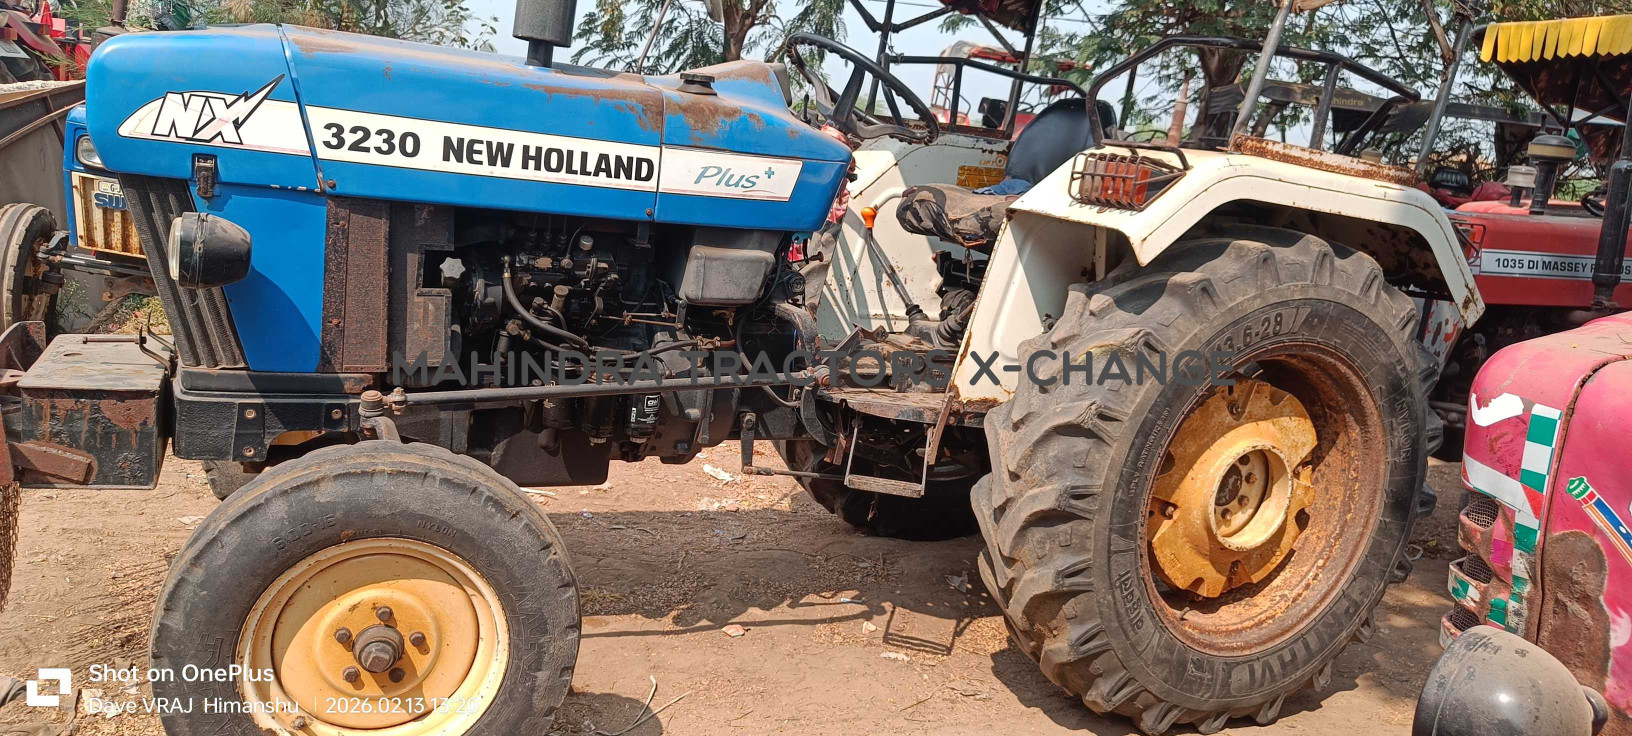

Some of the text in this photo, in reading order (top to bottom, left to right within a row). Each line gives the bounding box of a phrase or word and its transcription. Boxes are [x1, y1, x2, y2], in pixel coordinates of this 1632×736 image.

[151, 73, 286, 145] NX
[1321, 95, 1364, 106] hindra
[322, 122, 421, 158] 3230
[442, 135, 514, 168] NEW
[521, 144, 655, 182] HOLLAND
[1495, 257, 1524, 269] 1035
[1527, 260, 1539, 271] DI
[1541, 261, 1588, 273] MASSEY
[1395, 398, 1411, 464] NYLON
[417, 519, 457, 538] NYLON
